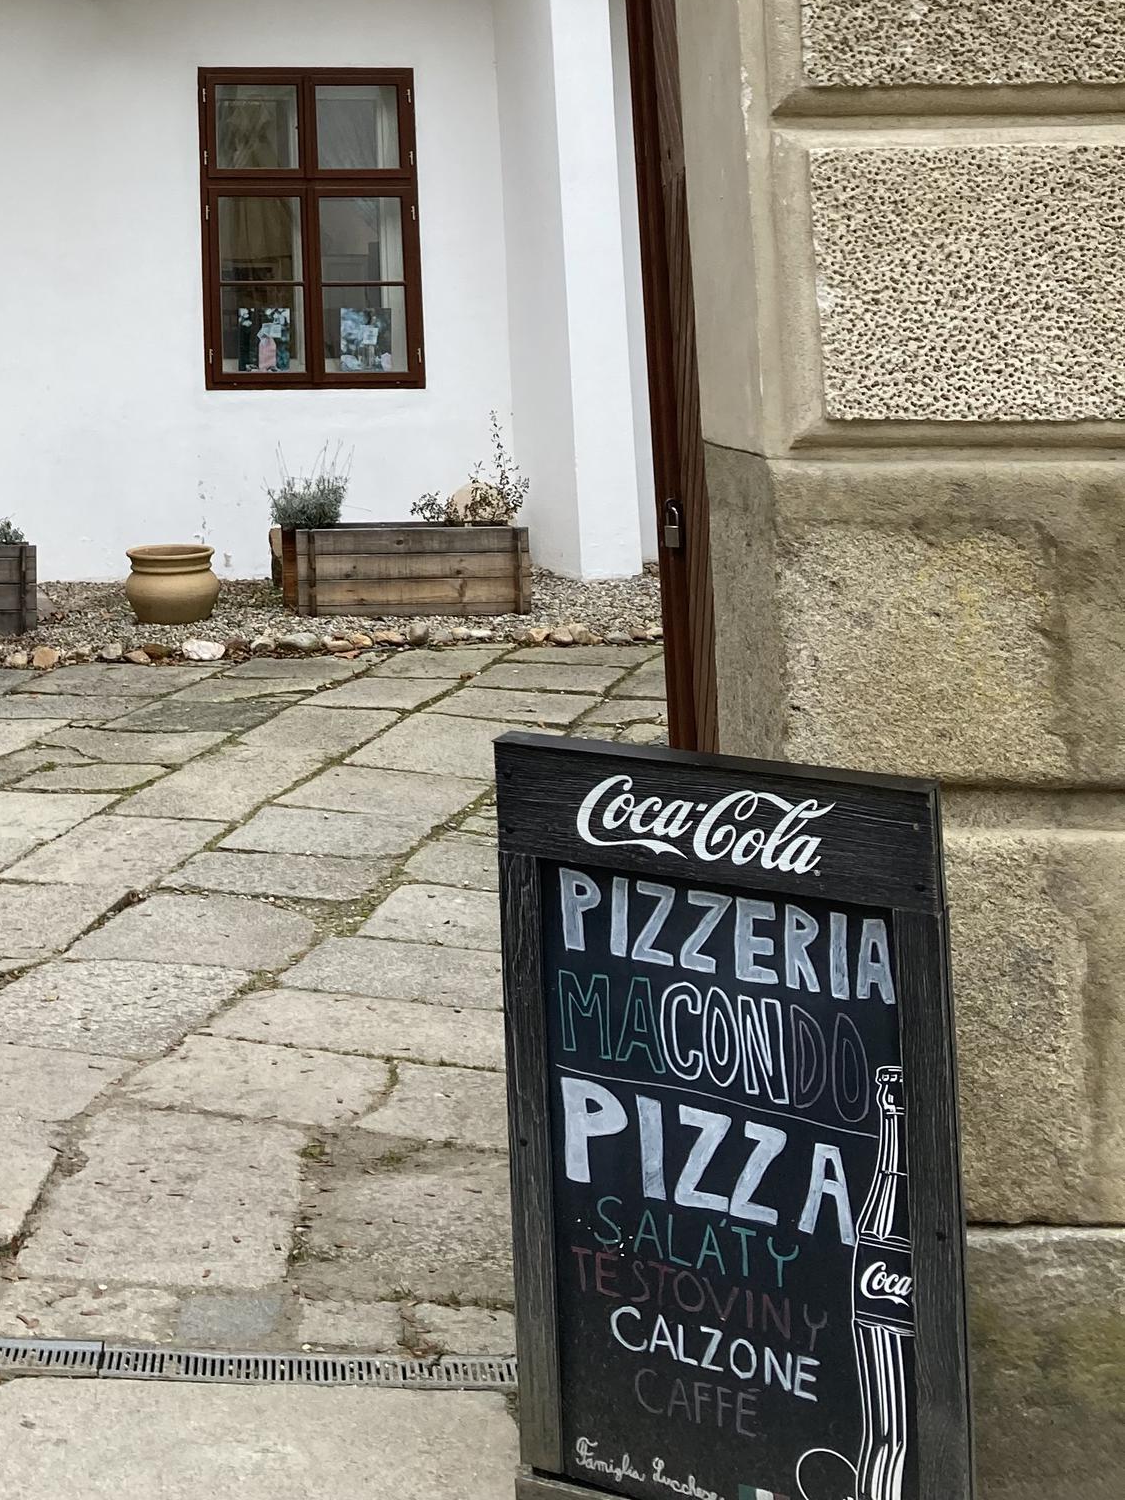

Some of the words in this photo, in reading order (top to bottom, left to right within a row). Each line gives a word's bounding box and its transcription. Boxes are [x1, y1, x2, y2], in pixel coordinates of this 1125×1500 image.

[576, 775, 836, 875] Coca-Cola
[559, 867, 896, 1004] PIZZERIA
[558, 969, 870, 1122] MACONDO
[560, 1076, 856, 1247] PIZZA
[594, 1196, 800, 1288] SALÁTY
[861, 1261, 913, 1307] Coca
[610, 1306, 821, 1401] CALZONE
[575, 1436, 646, 1482] Famiglia
